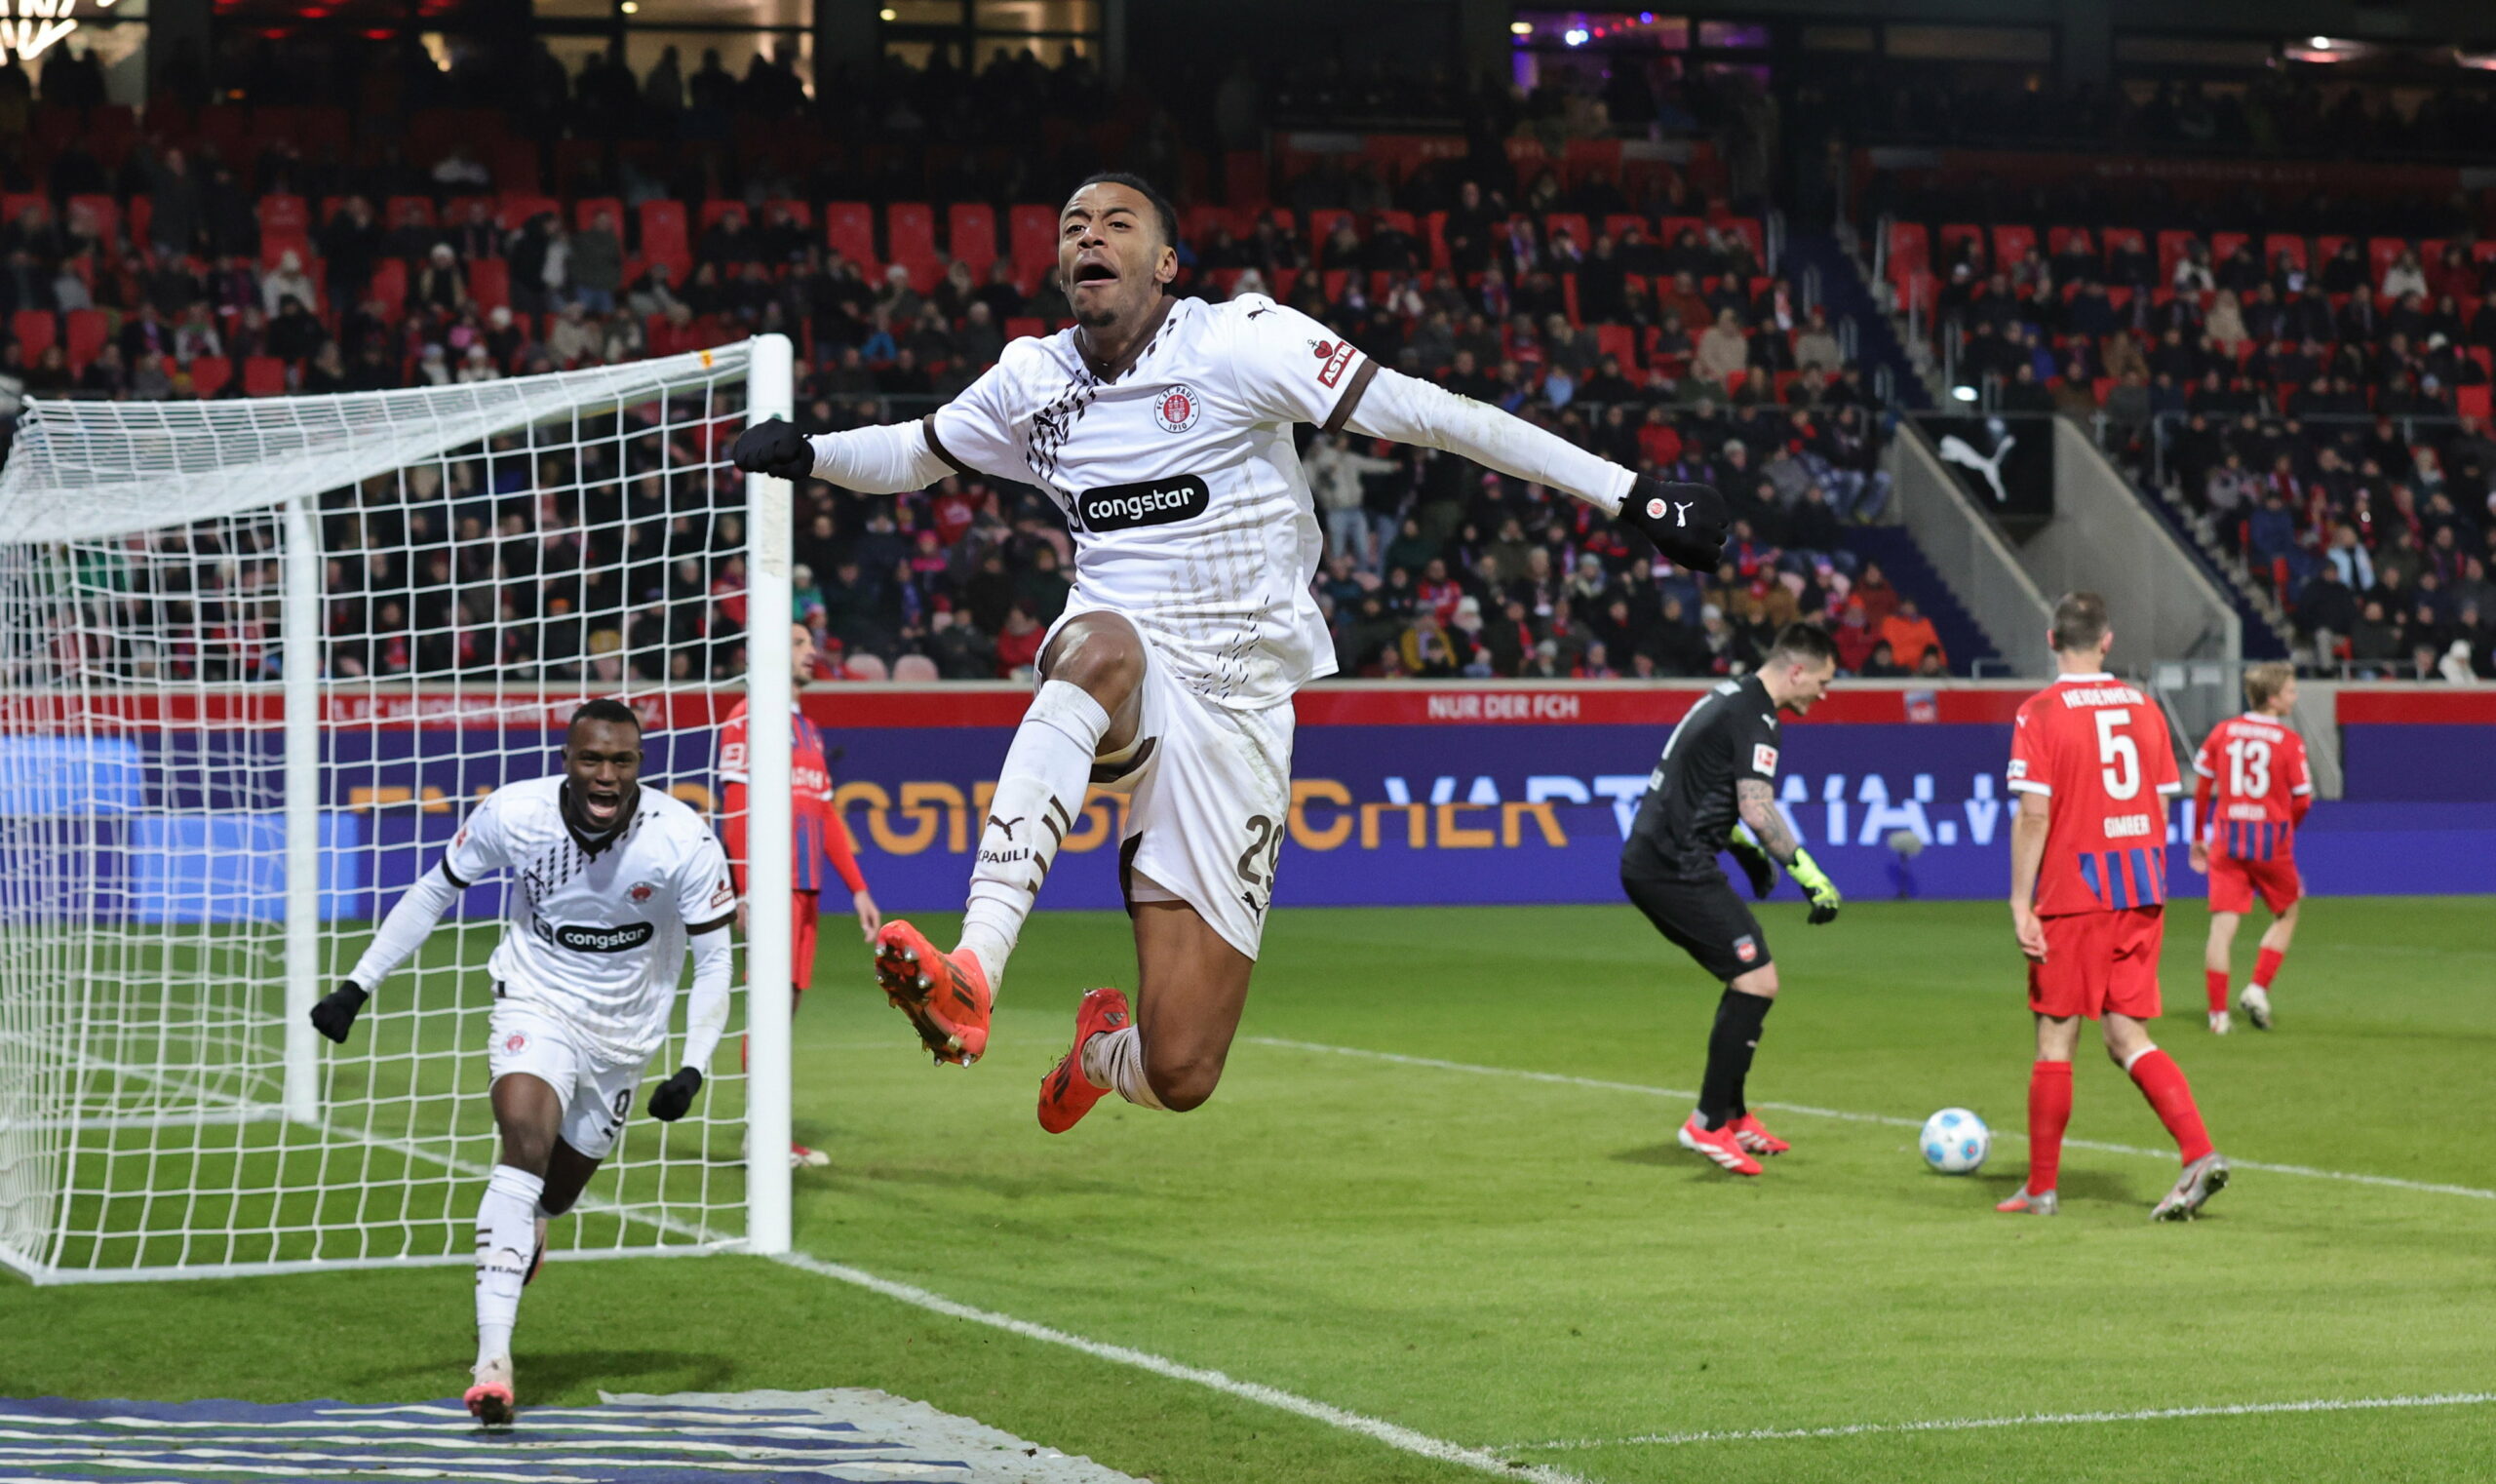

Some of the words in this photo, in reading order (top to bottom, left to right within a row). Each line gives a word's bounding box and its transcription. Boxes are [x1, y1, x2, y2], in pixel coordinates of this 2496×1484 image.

[1088, 488, 1194, 520] congstar
[1427, 695, 1480, 719] NUR
[1485, 695, 1529, 719] DER
[1533, 695, 1580, 719] FCH
[2061, 686, 2144, 709] HEIDENHEIM
[2094, 709, 2141, 801] 5
[2225, 738, 2271, 808] 13
[2103, 814, 2151, 839] GIMBER
[1237, 815, 1283, 892] 29
[565, 927, 646, 950] congstar
